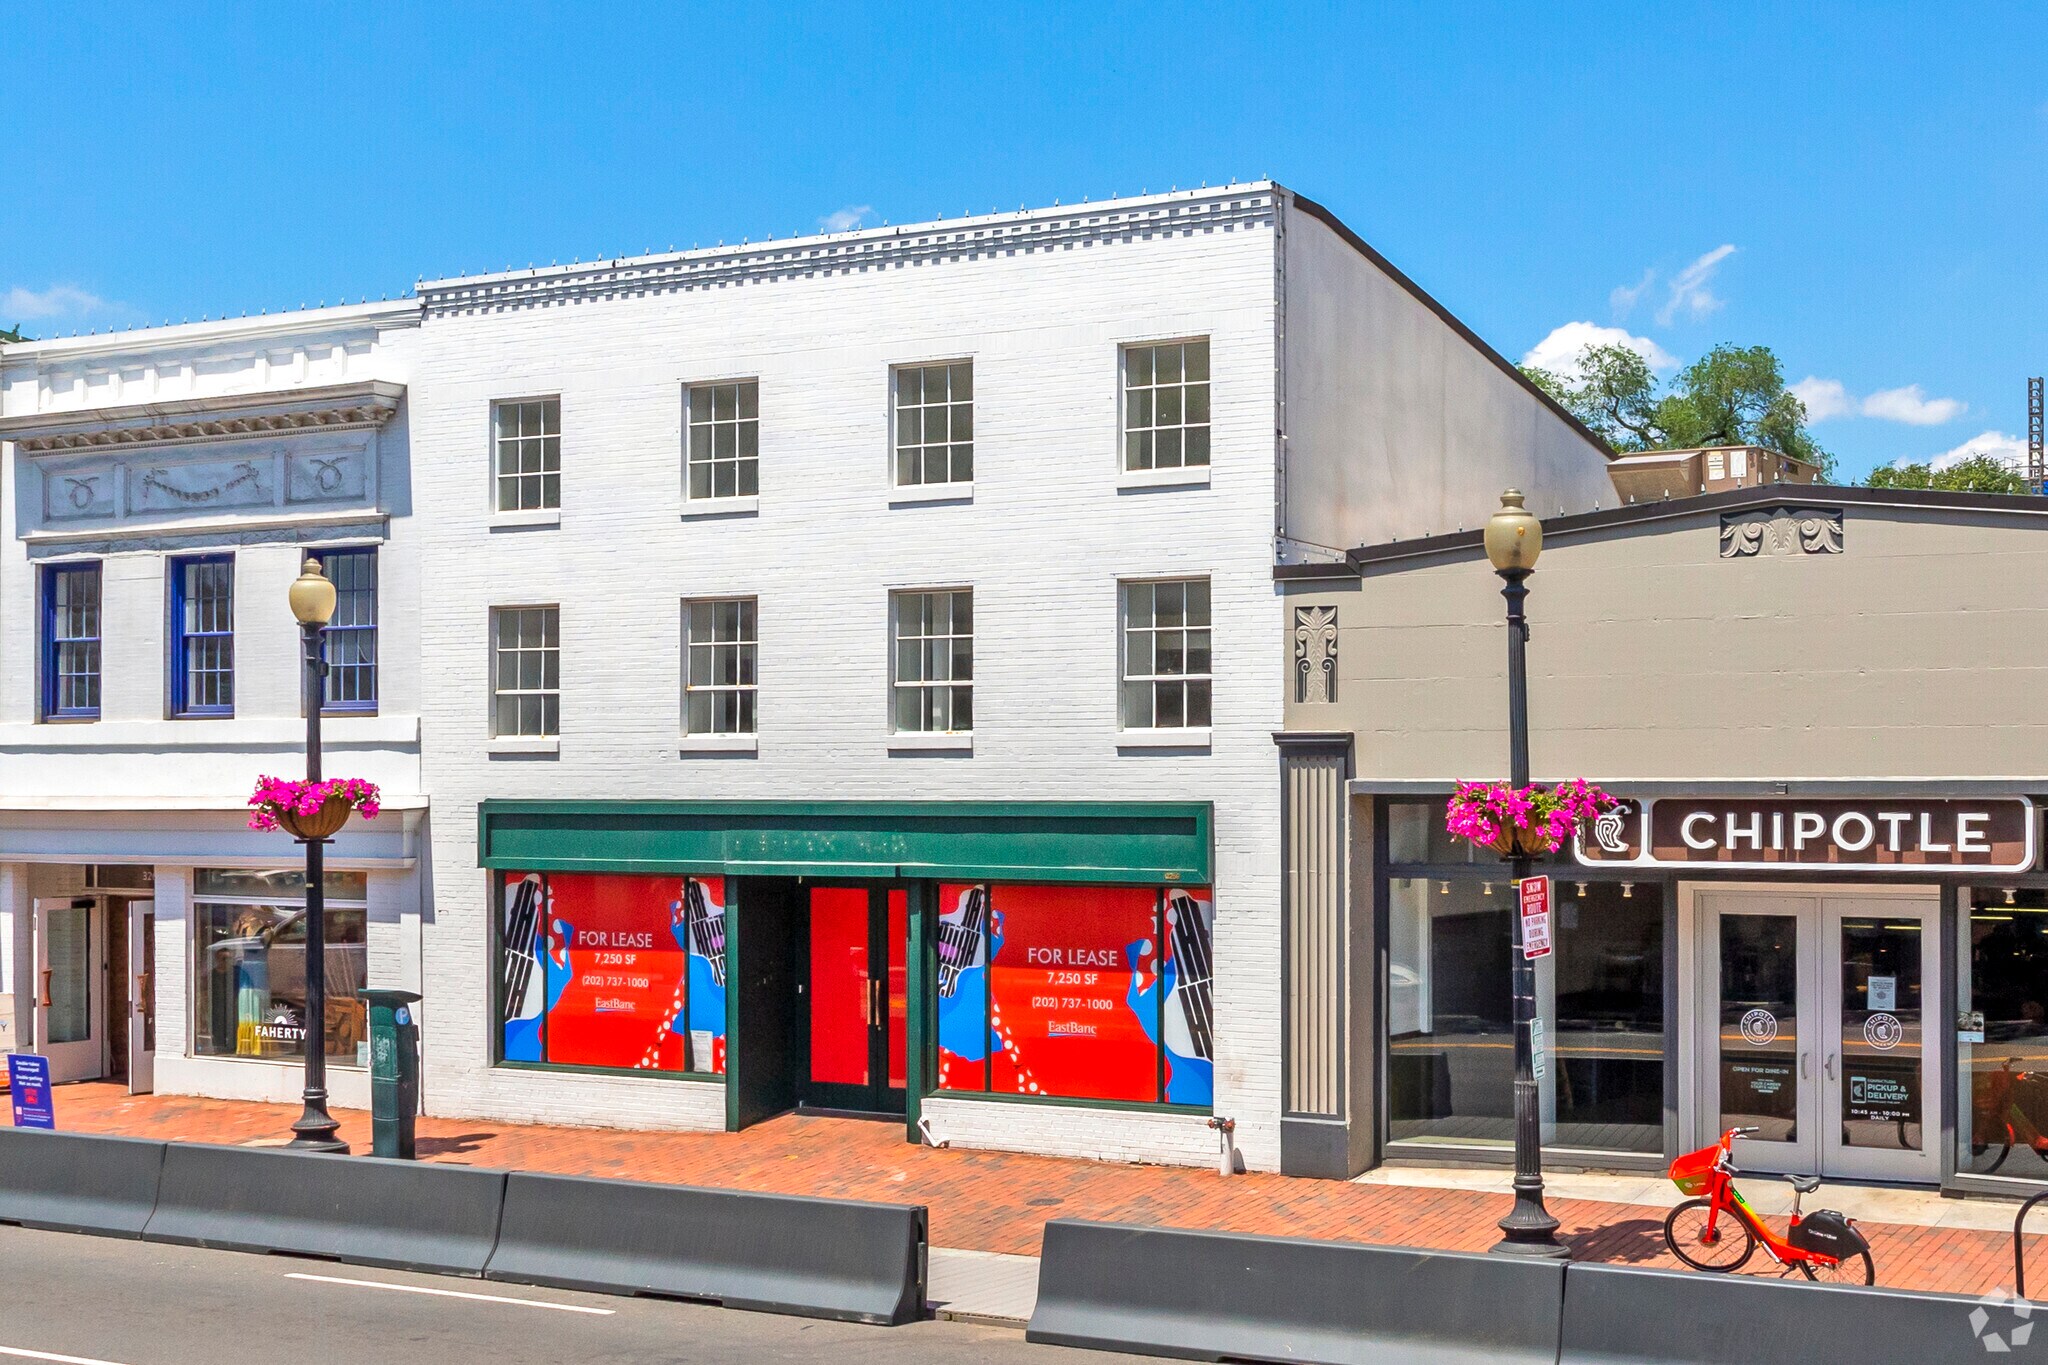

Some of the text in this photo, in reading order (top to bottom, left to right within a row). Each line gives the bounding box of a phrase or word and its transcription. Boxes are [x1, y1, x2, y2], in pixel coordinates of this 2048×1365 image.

[1681, 811, 1992, 853] CHIPOTLE
[1526, 881, 1542, 894] SNOW
[1523, 893, 1545, 904] EMERGENCY
[1527, 902, 1542, 915] ROUTE
[1525, 915, 1546, 927] NO PARKING
[579, 931, 653, 948] FOR LEASE
[1529, 927, 1544, 939] DURING
[1527, 939, 1547, 951] EMERGENCY
[595, 953, 636, 965] 7,250 SF
[1028, 947, 1118, 967] FOR LEASE
[582, 975, 649, 988] (202) 737-1000
[1047, 972, 1098, 985] 7,250 SF
[595, 997, 635, 1009] EastBanc
[1032, 997, 1113, 1011] (202) 737-1000
[1744, 1011, 1774, 1026] CHIPOTLE
[1867, 1015, 1899, 1030] CHIPOTLE
[254, 1025, 307, 1040] FAHERTY
[1048, 1020, 1097, 1034] EastBanc
[1867, 1084, 1898, 1092] PICKUP
[1867, 1092, 1909, 1101] DELIVERY
